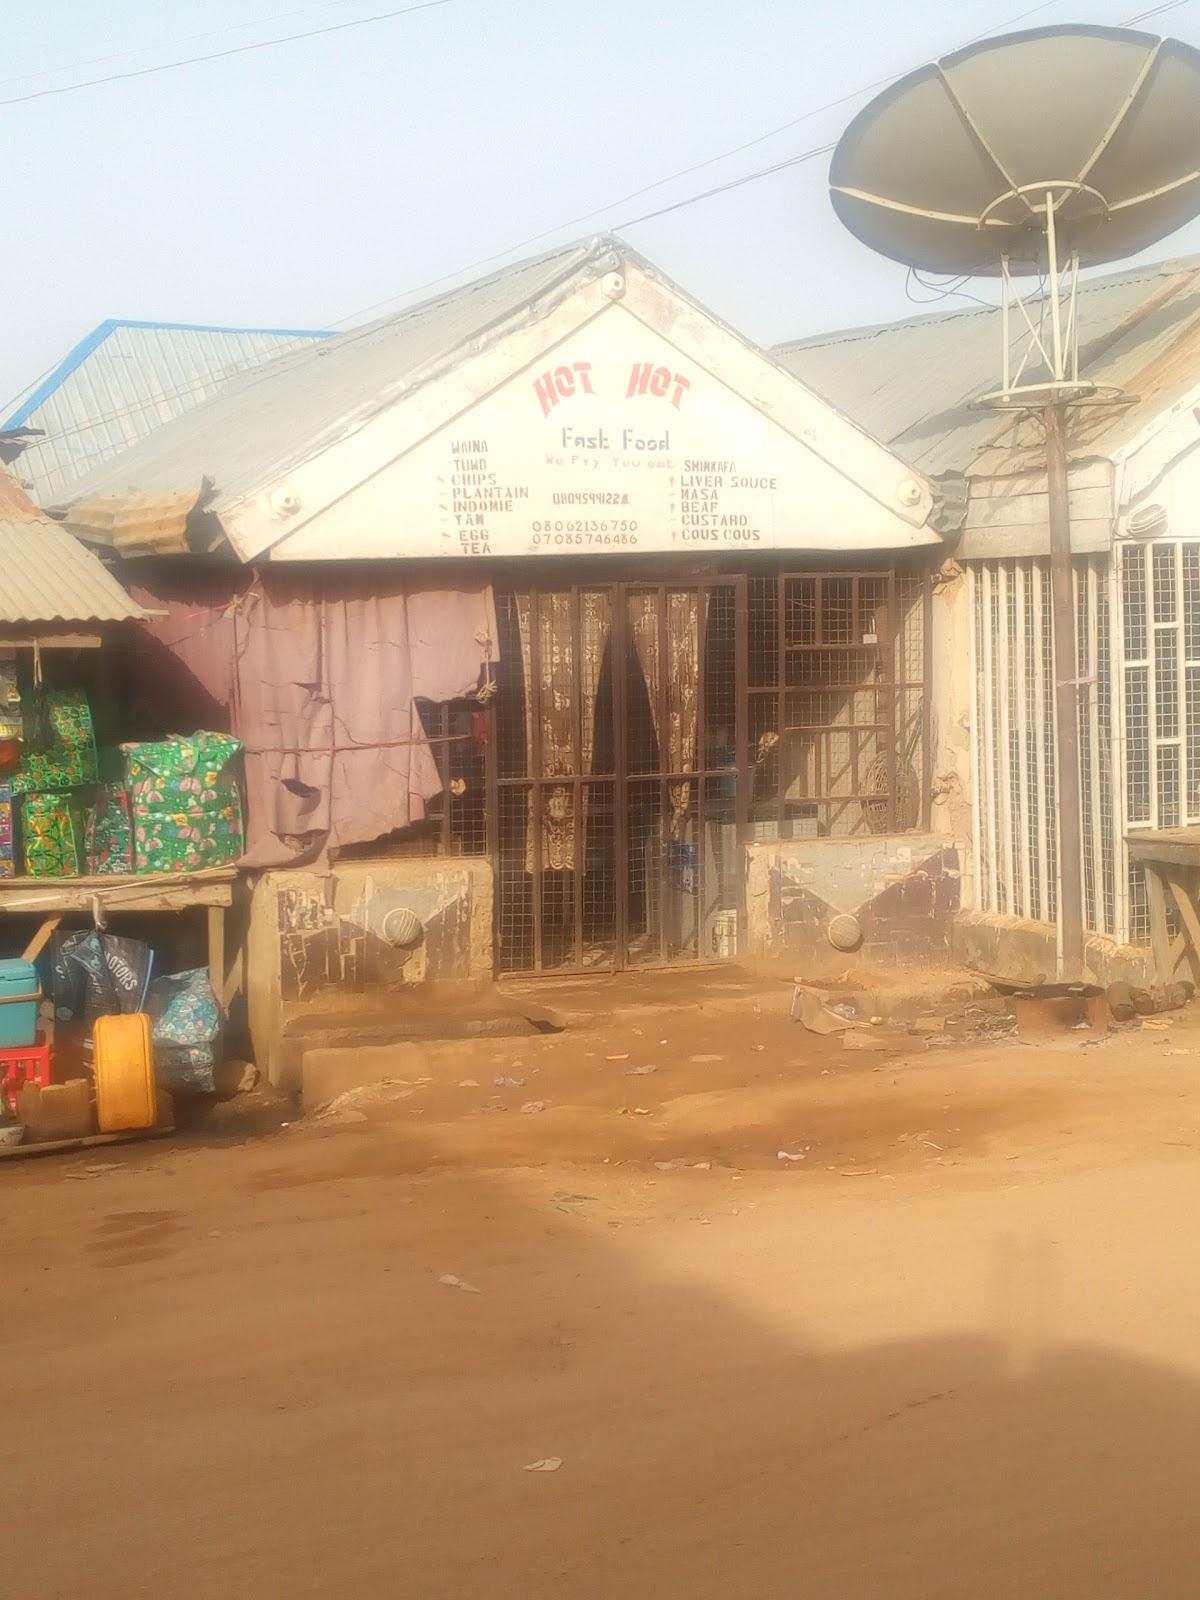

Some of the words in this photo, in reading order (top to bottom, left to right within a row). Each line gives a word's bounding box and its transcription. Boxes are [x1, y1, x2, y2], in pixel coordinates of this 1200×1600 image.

[532, 361, 595, 417] HOT
[625, 362, 691, 411] HOT
[562, 427, 609, 450] Fast
[622, 428, 669, 452] Food
[611, 456, 641, 468] You
[451, 473, 496, 486] CHIPS
[681, 475, 722, 488] LIVER
[730, 476, 777, 490] SOUCE
[452, 486, 528, 498] PLANTAIN
[681, 488, 719, 500] MASA
[453, 500, 513, 512] INDOMIE
[681, 501, 719, 513] BEAF
[454, 513, 485, 526] YAM
[681, 514, 748, 526] CUSTARD
[459, 529, 489, 541] EGG
[681, 529, 719, 541] COUS
[723, 529, 761, 541] COUS
[460, 542, 492, 554] TEA
